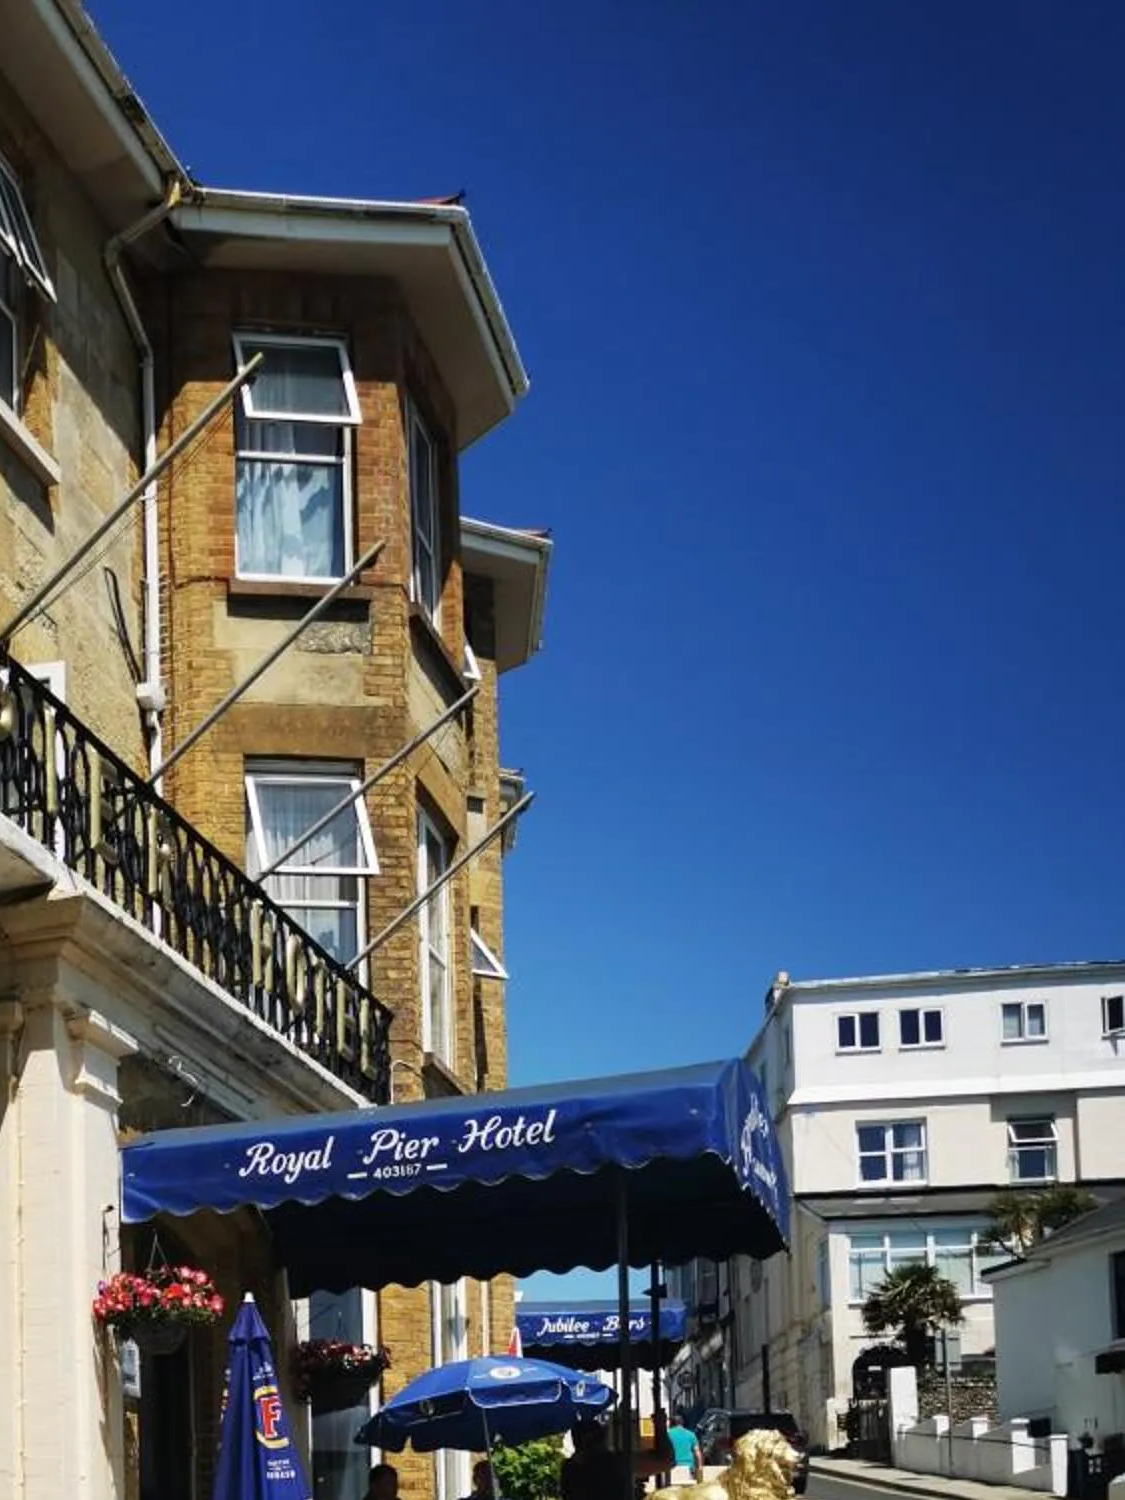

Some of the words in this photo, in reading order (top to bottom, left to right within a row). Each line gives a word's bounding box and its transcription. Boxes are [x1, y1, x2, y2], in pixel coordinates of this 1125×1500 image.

[238, 1135, 335, 1184] Royal
[362, 1128, 440, 1165] Pier
[458, 1108, 557, 1154] Hotel
[536, 1316, 590, 1337] Jubilee
[602, 1314, 646, 1331] Brs
